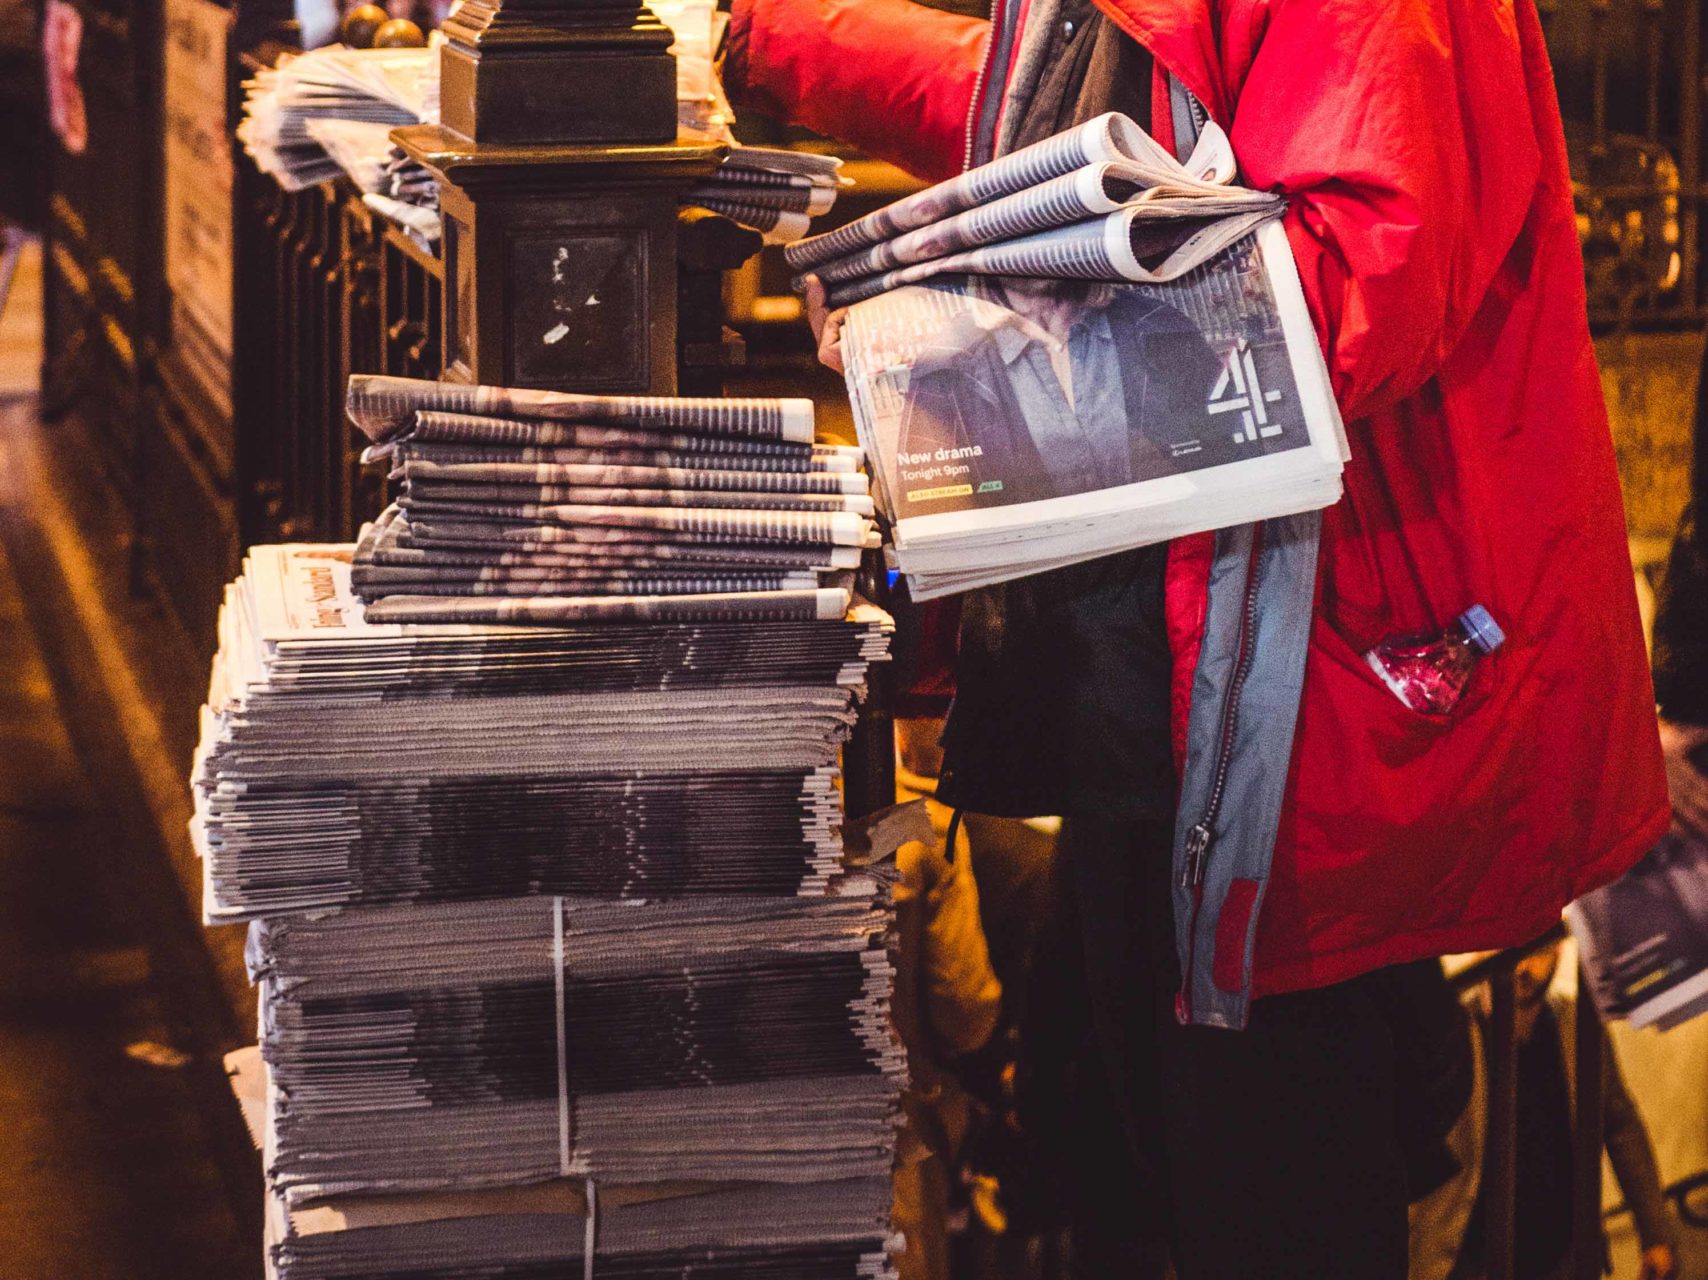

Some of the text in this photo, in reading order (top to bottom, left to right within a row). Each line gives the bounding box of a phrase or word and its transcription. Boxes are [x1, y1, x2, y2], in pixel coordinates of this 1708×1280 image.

[897, 445, 983, 466] New drama
[902, 463, 970, 481] Tonight 9pm
